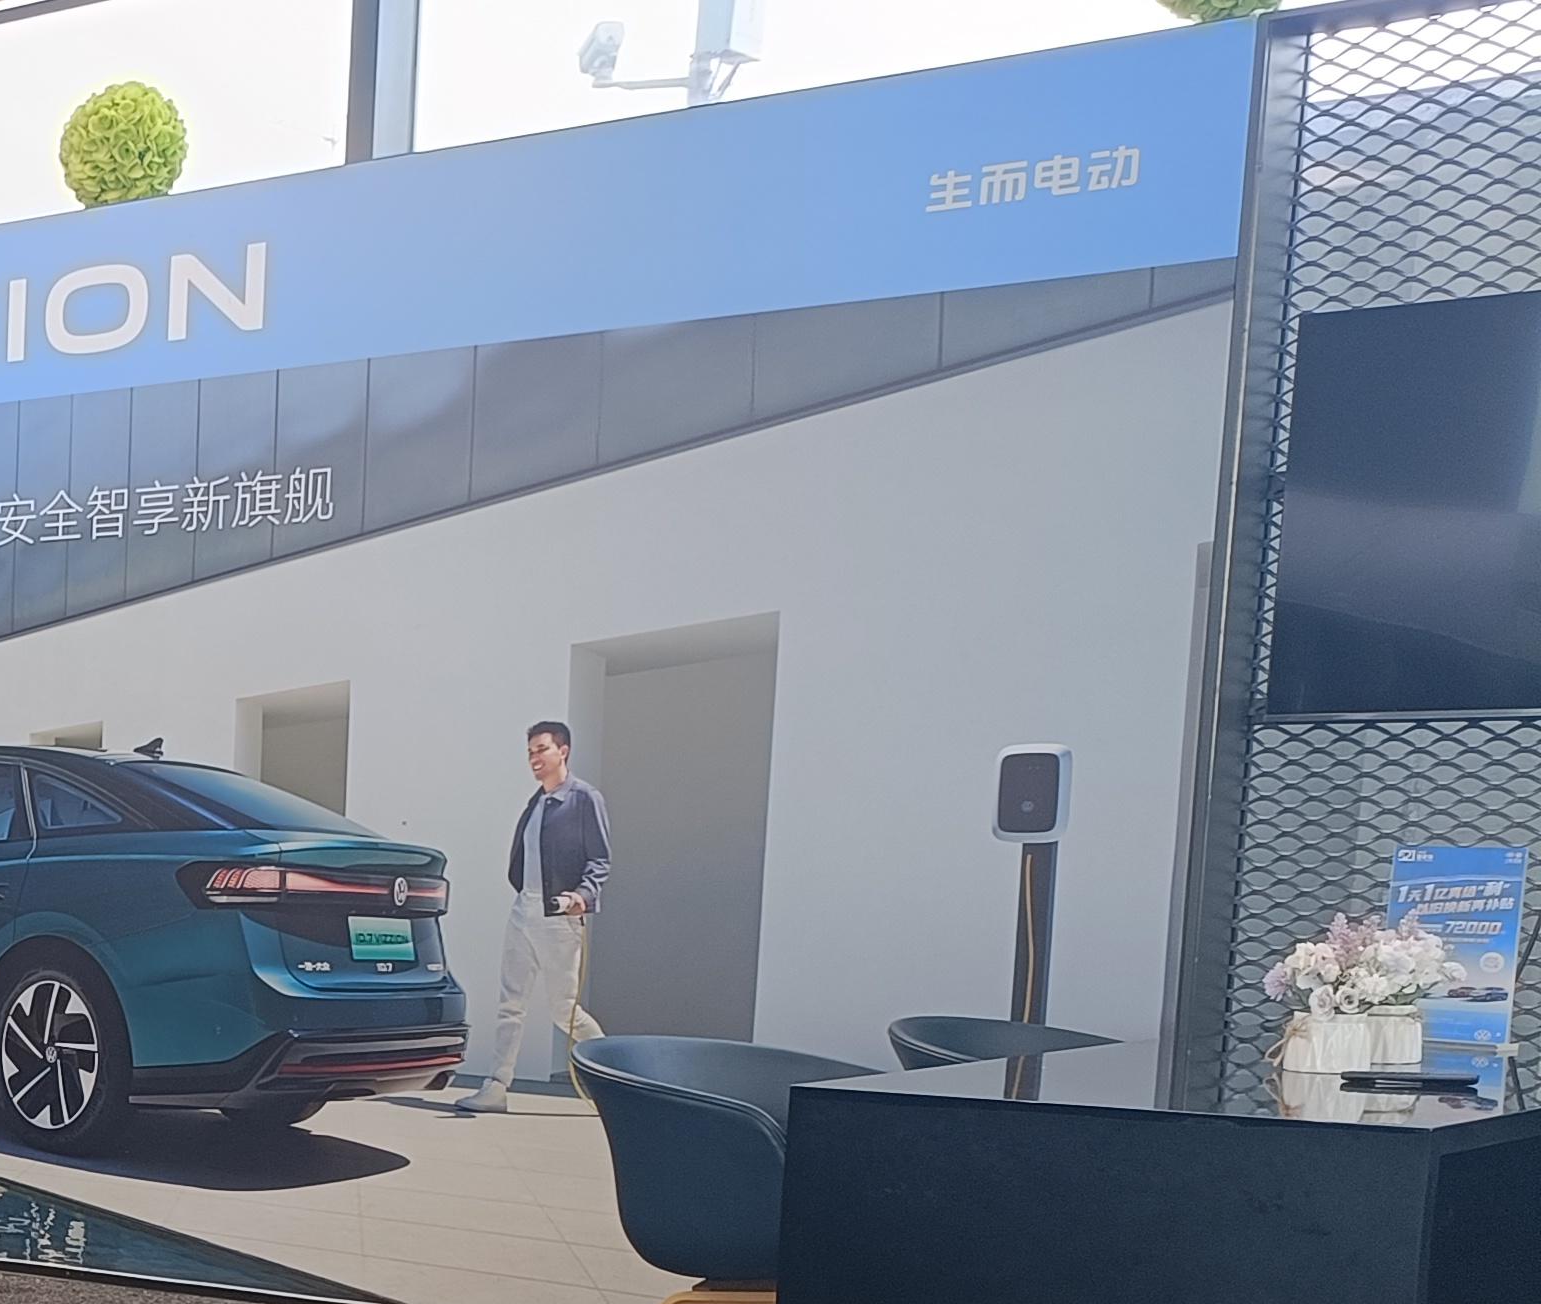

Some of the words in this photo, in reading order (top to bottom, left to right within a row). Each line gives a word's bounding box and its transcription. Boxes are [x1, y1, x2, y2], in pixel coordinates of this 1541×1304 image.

[925, 145, 1141, 212] 生而电动
[1445, 921, 1502, 935] 72000
